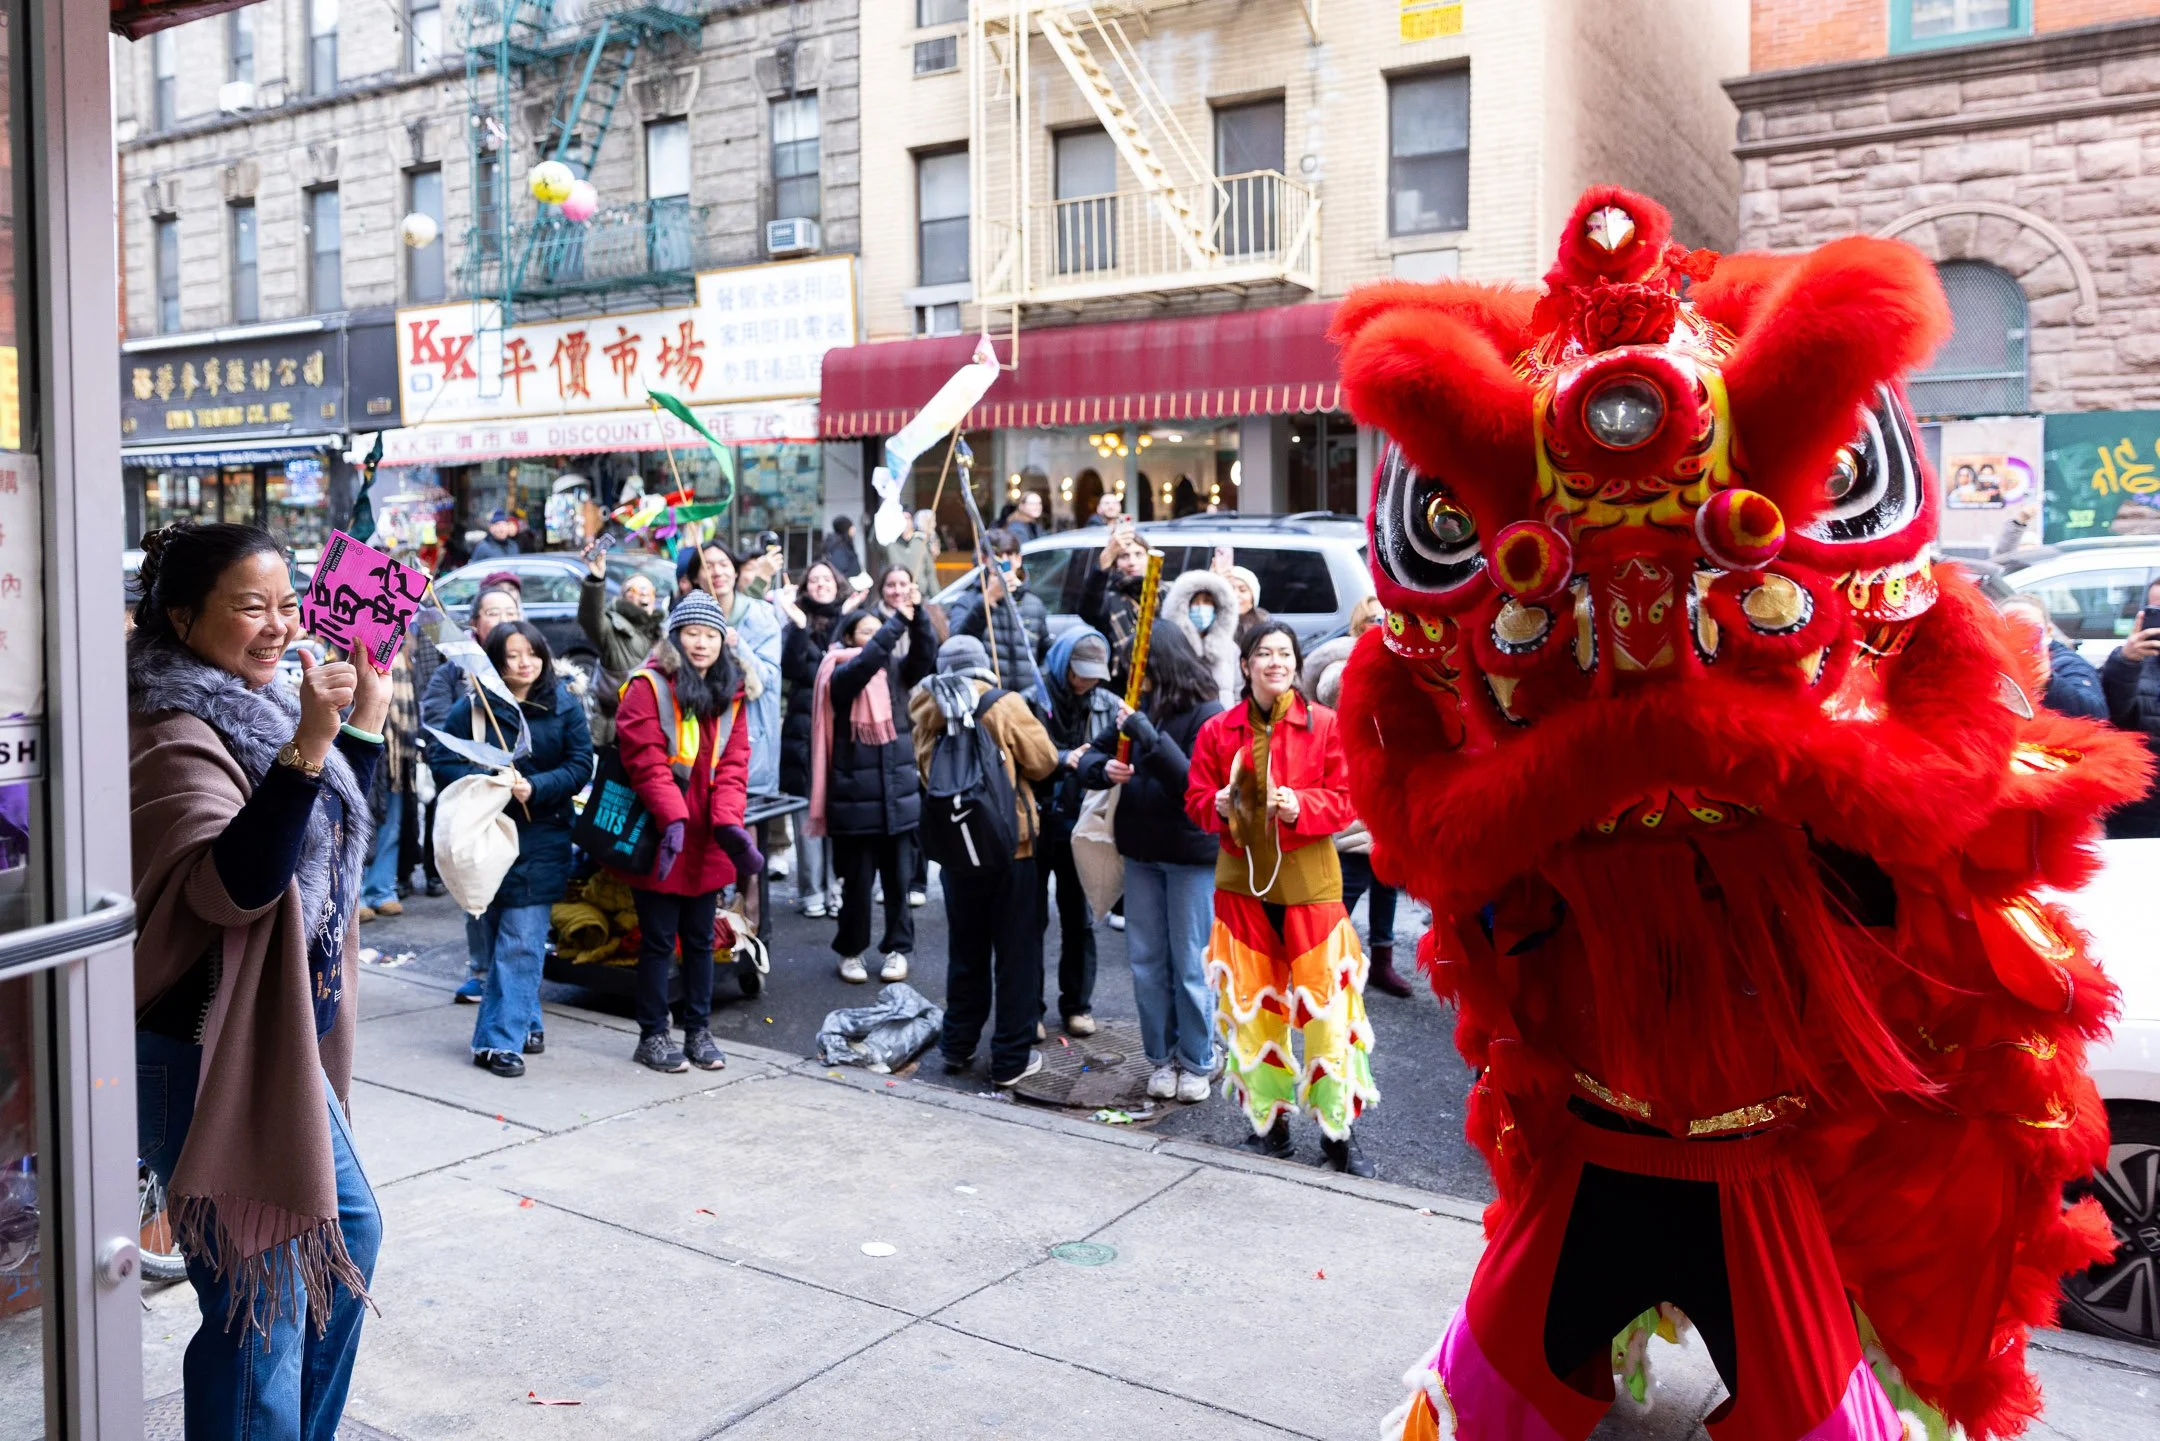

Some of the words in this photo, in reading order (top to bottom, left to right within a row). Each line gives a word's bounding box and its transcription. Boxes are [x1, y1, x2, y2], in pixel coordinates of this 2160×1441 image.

[408, 319, 476, 380] KK
[500, 320, 705, 406] 平價市場
[548, 422, 650, 445] DISCOUNT
[664, 416, 736, 440] STRE
[315, 570, 327, 586] FROM
[322, 537, 341, 570] CHINATOWN
[329, 554, 340, 570] WITH
[336, 540, 347, 555] LOVE
[375, 641, 387, 660] LUNAR
[380, 650, 390, 663] NEW
[386, 636, 396, 651] YEAR
[392, 624, 401, 637] 2025
[593, 806, 627, 835] ARTS
